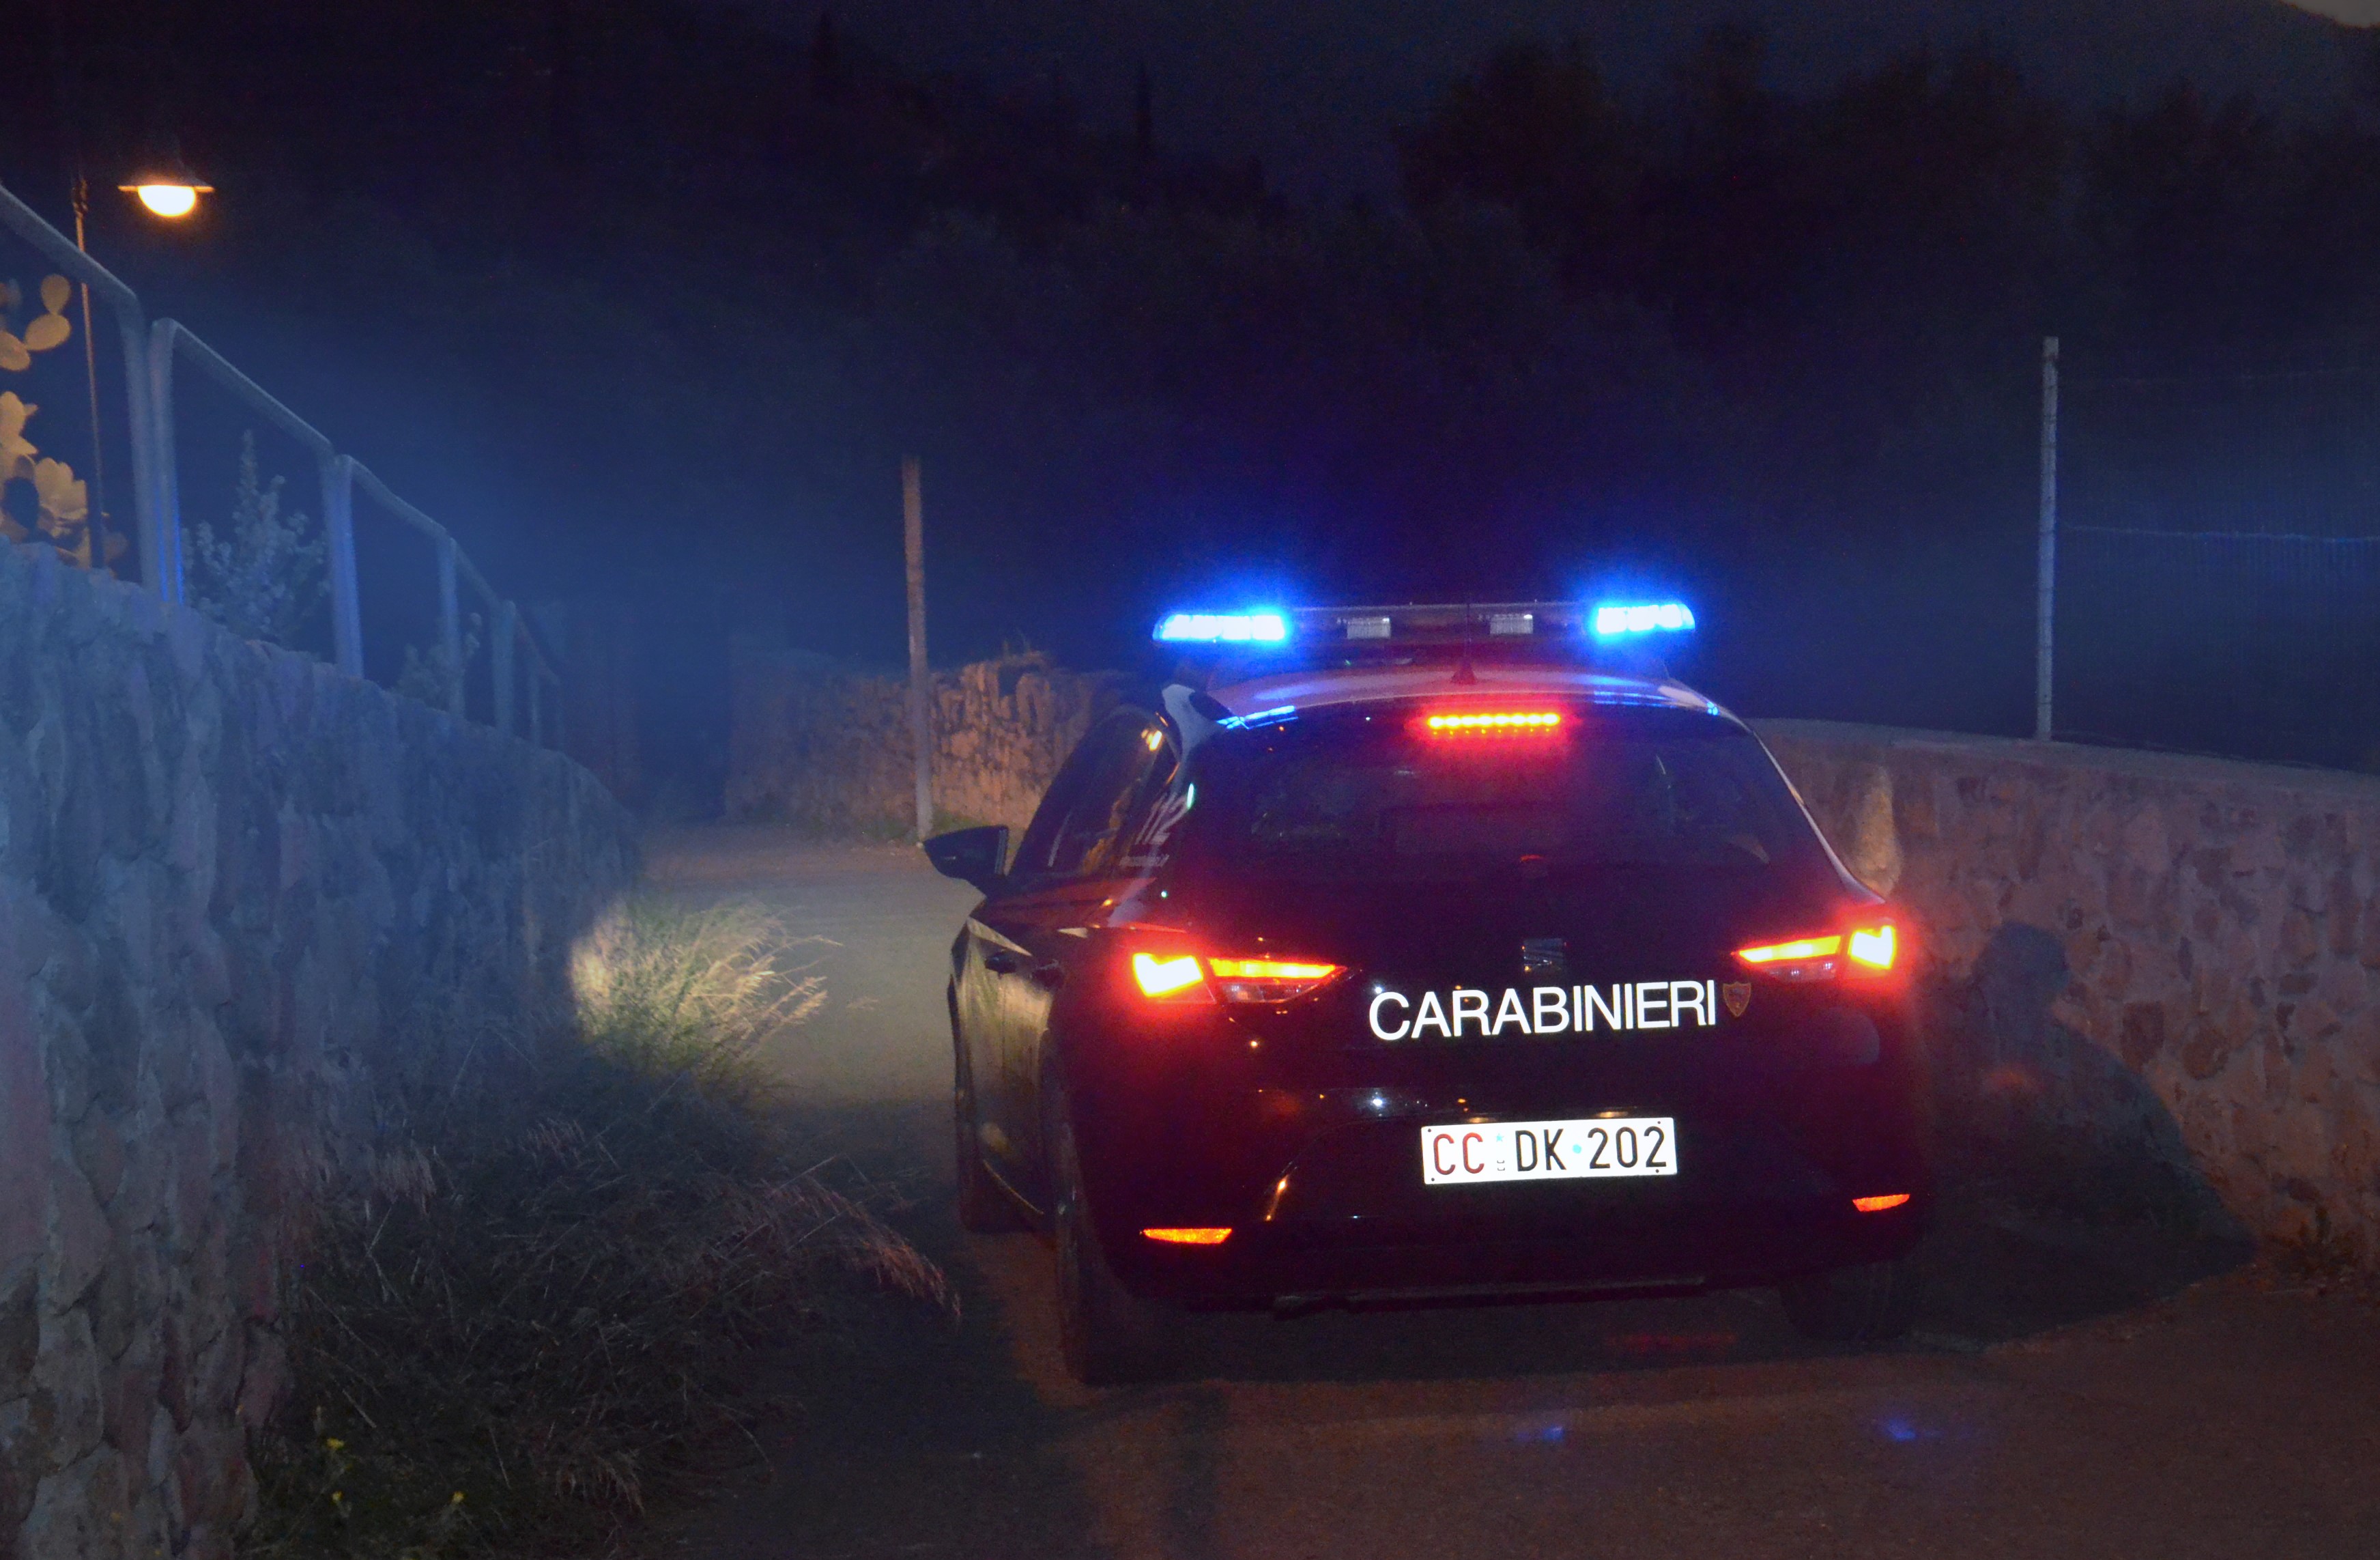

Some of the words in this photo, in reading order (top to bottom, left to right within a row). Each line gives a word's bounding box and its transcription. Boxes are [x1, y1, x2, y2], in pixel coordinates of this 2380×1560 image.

[1369, 980, 1715, 1040] CARABINIERI
[1433, 1133, 1485, 1176] CC
[1515, 1129, 1567, 1172] DK
[1588, 1126, 1667, 1169] 202
